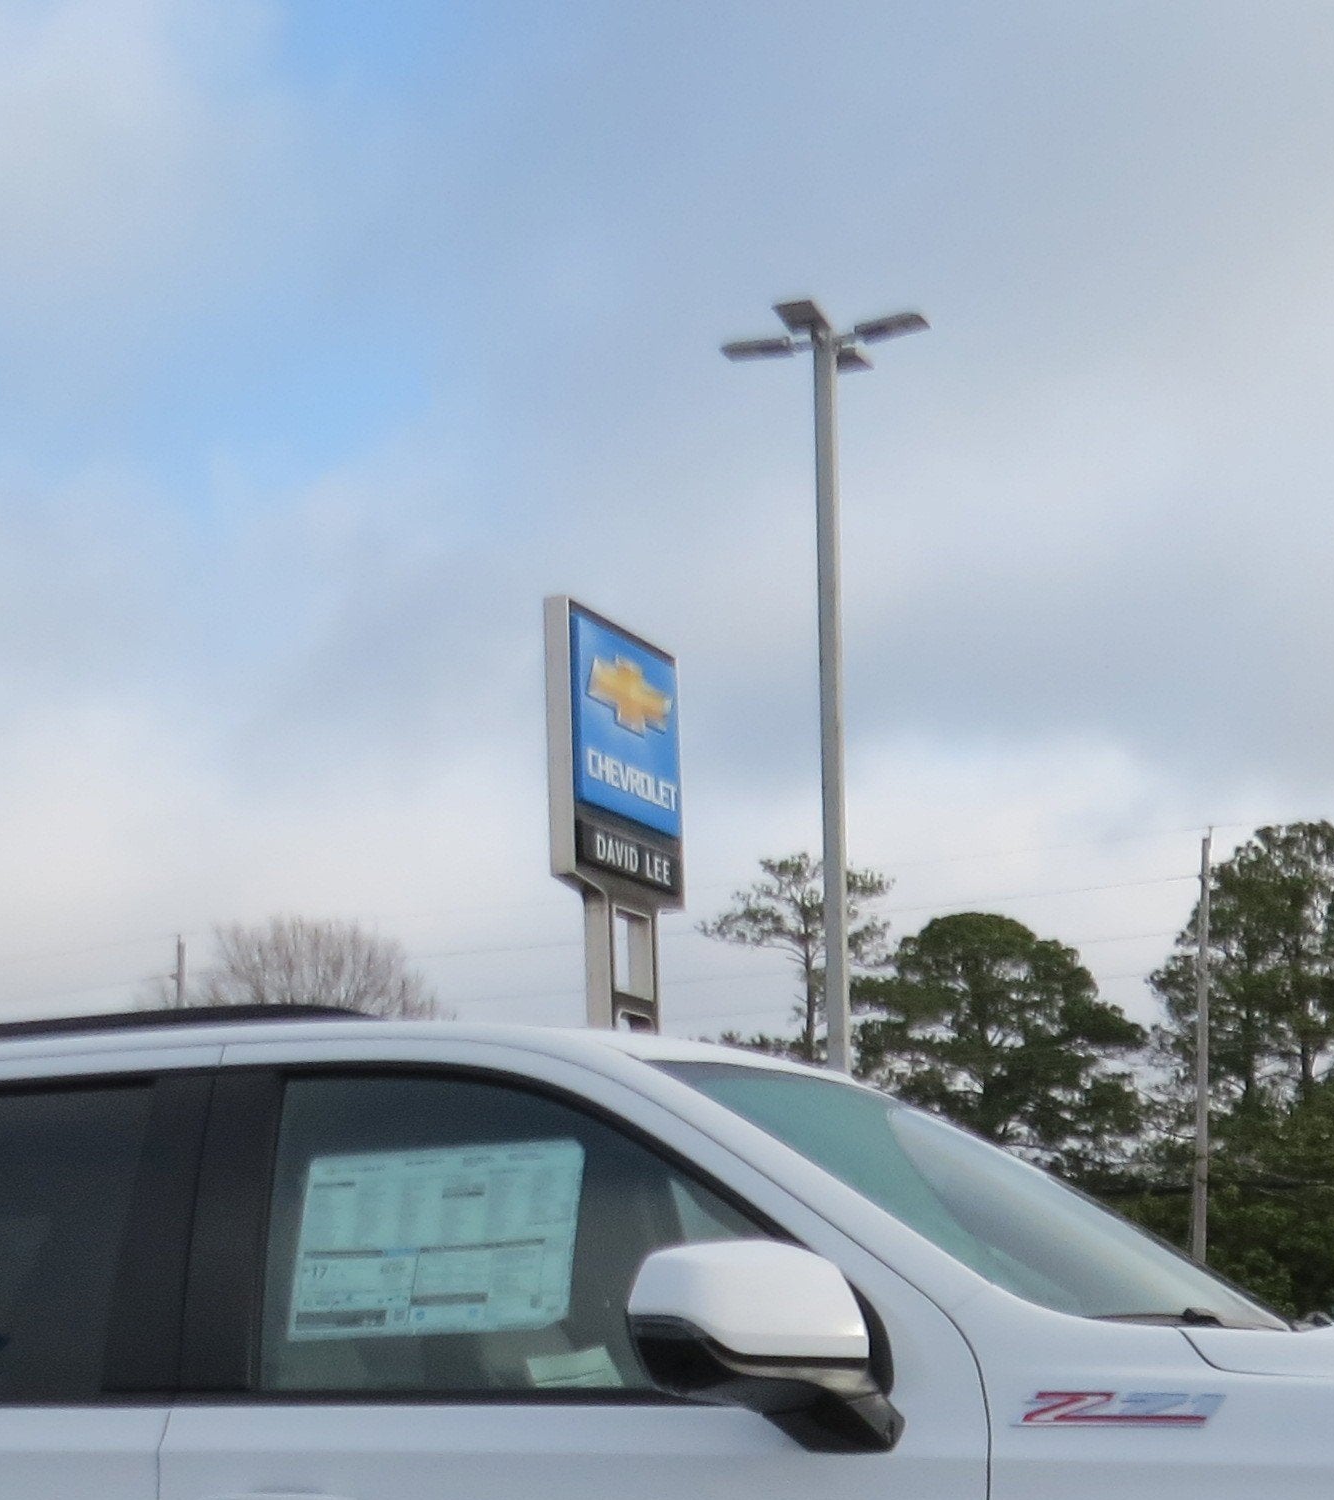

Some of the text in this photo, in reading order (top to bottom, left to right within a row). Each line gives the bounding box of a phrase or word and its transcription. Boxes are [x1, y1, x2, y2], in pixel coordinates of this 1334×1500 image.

[586, 749, 677, 812] CHEVROLET
[596, 834, 672, 886] DAVID LEE
[1018, 1391, 1227, 1427] Z71
